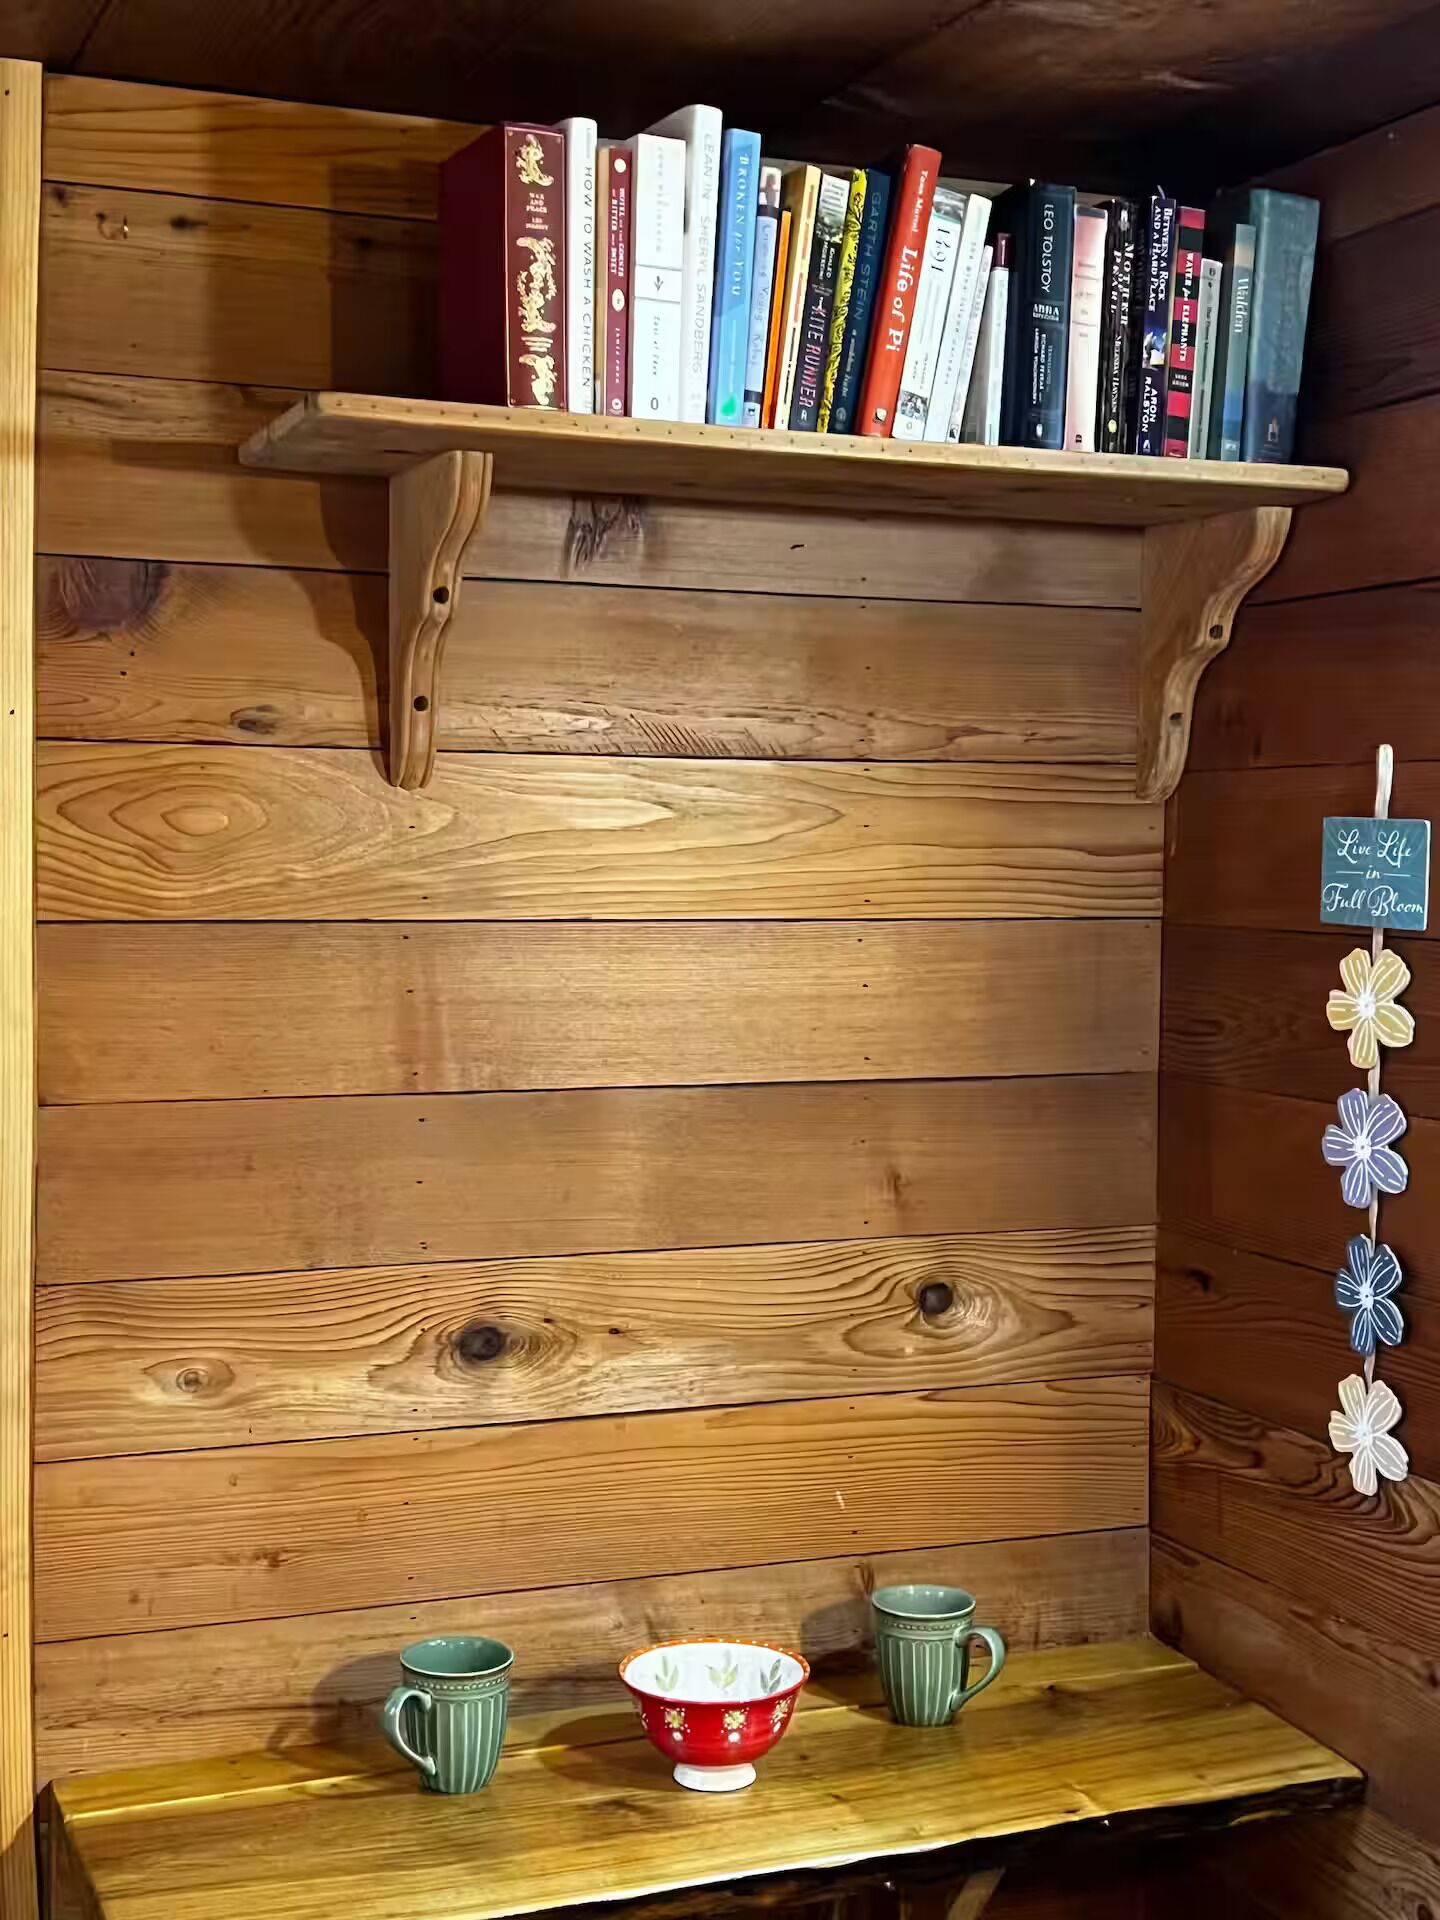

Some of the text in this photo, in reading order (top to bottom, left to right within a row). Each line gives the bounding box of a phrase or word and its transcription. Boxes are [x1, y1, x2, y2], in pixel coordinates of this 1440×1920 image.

[583, 166, 593, 207] HOW
[736, 155, 749, 225] BROKEN
[917, 170, 929, 196] Yann
[583, 215, 593, 234] TO
[864, 191, 882, 257] GARTH
[1153, 205, 1162, 230] AND
[583, 242, 593, 288] WASH
[691, 133, 714, 374] LEAN IN SHERYL SANDBERG
[896, 246, 920, 292] Life
[1040, 204, 1055, 293] LEO TOLSTOY
[1151, 242, 1161, 276] HARD
[1157, 207, 1173, 301] BETWEEN A ROCK
[1184, 252, 1195, 286] WATER
[732, 259, 745, 296] YOU
[854, 264, 871, 321] STEIN
[1110, 250, 1123, 313] PEARL
[1120, 242, 1134, 326] MOTHER
[1148, 277, 1159, 312] PLACE
[582, 296, 592, 306] A
[891, 296, 906, 324] of
[1033, 303, 1060, 317] ANNA
[1234, 278, 1250, 333] Walden
[807, 304, 827, 343] KITE
[885, 328, 905, 352] Pi
[1178, 304, 1190, 362] ELEPHANTS
[582, 312, 592, 388] CHICKEN
[799, 343, 822, 408] RUNNER
[1141, 376, 1153, 433] RALSTON
[1150, 387, 1159, 424] ARON
[1337, 828, 1413, 869] Live Life
[1365, 864, 1381, 880] in
[1322, 883, 1424, 917] Full Bloom
